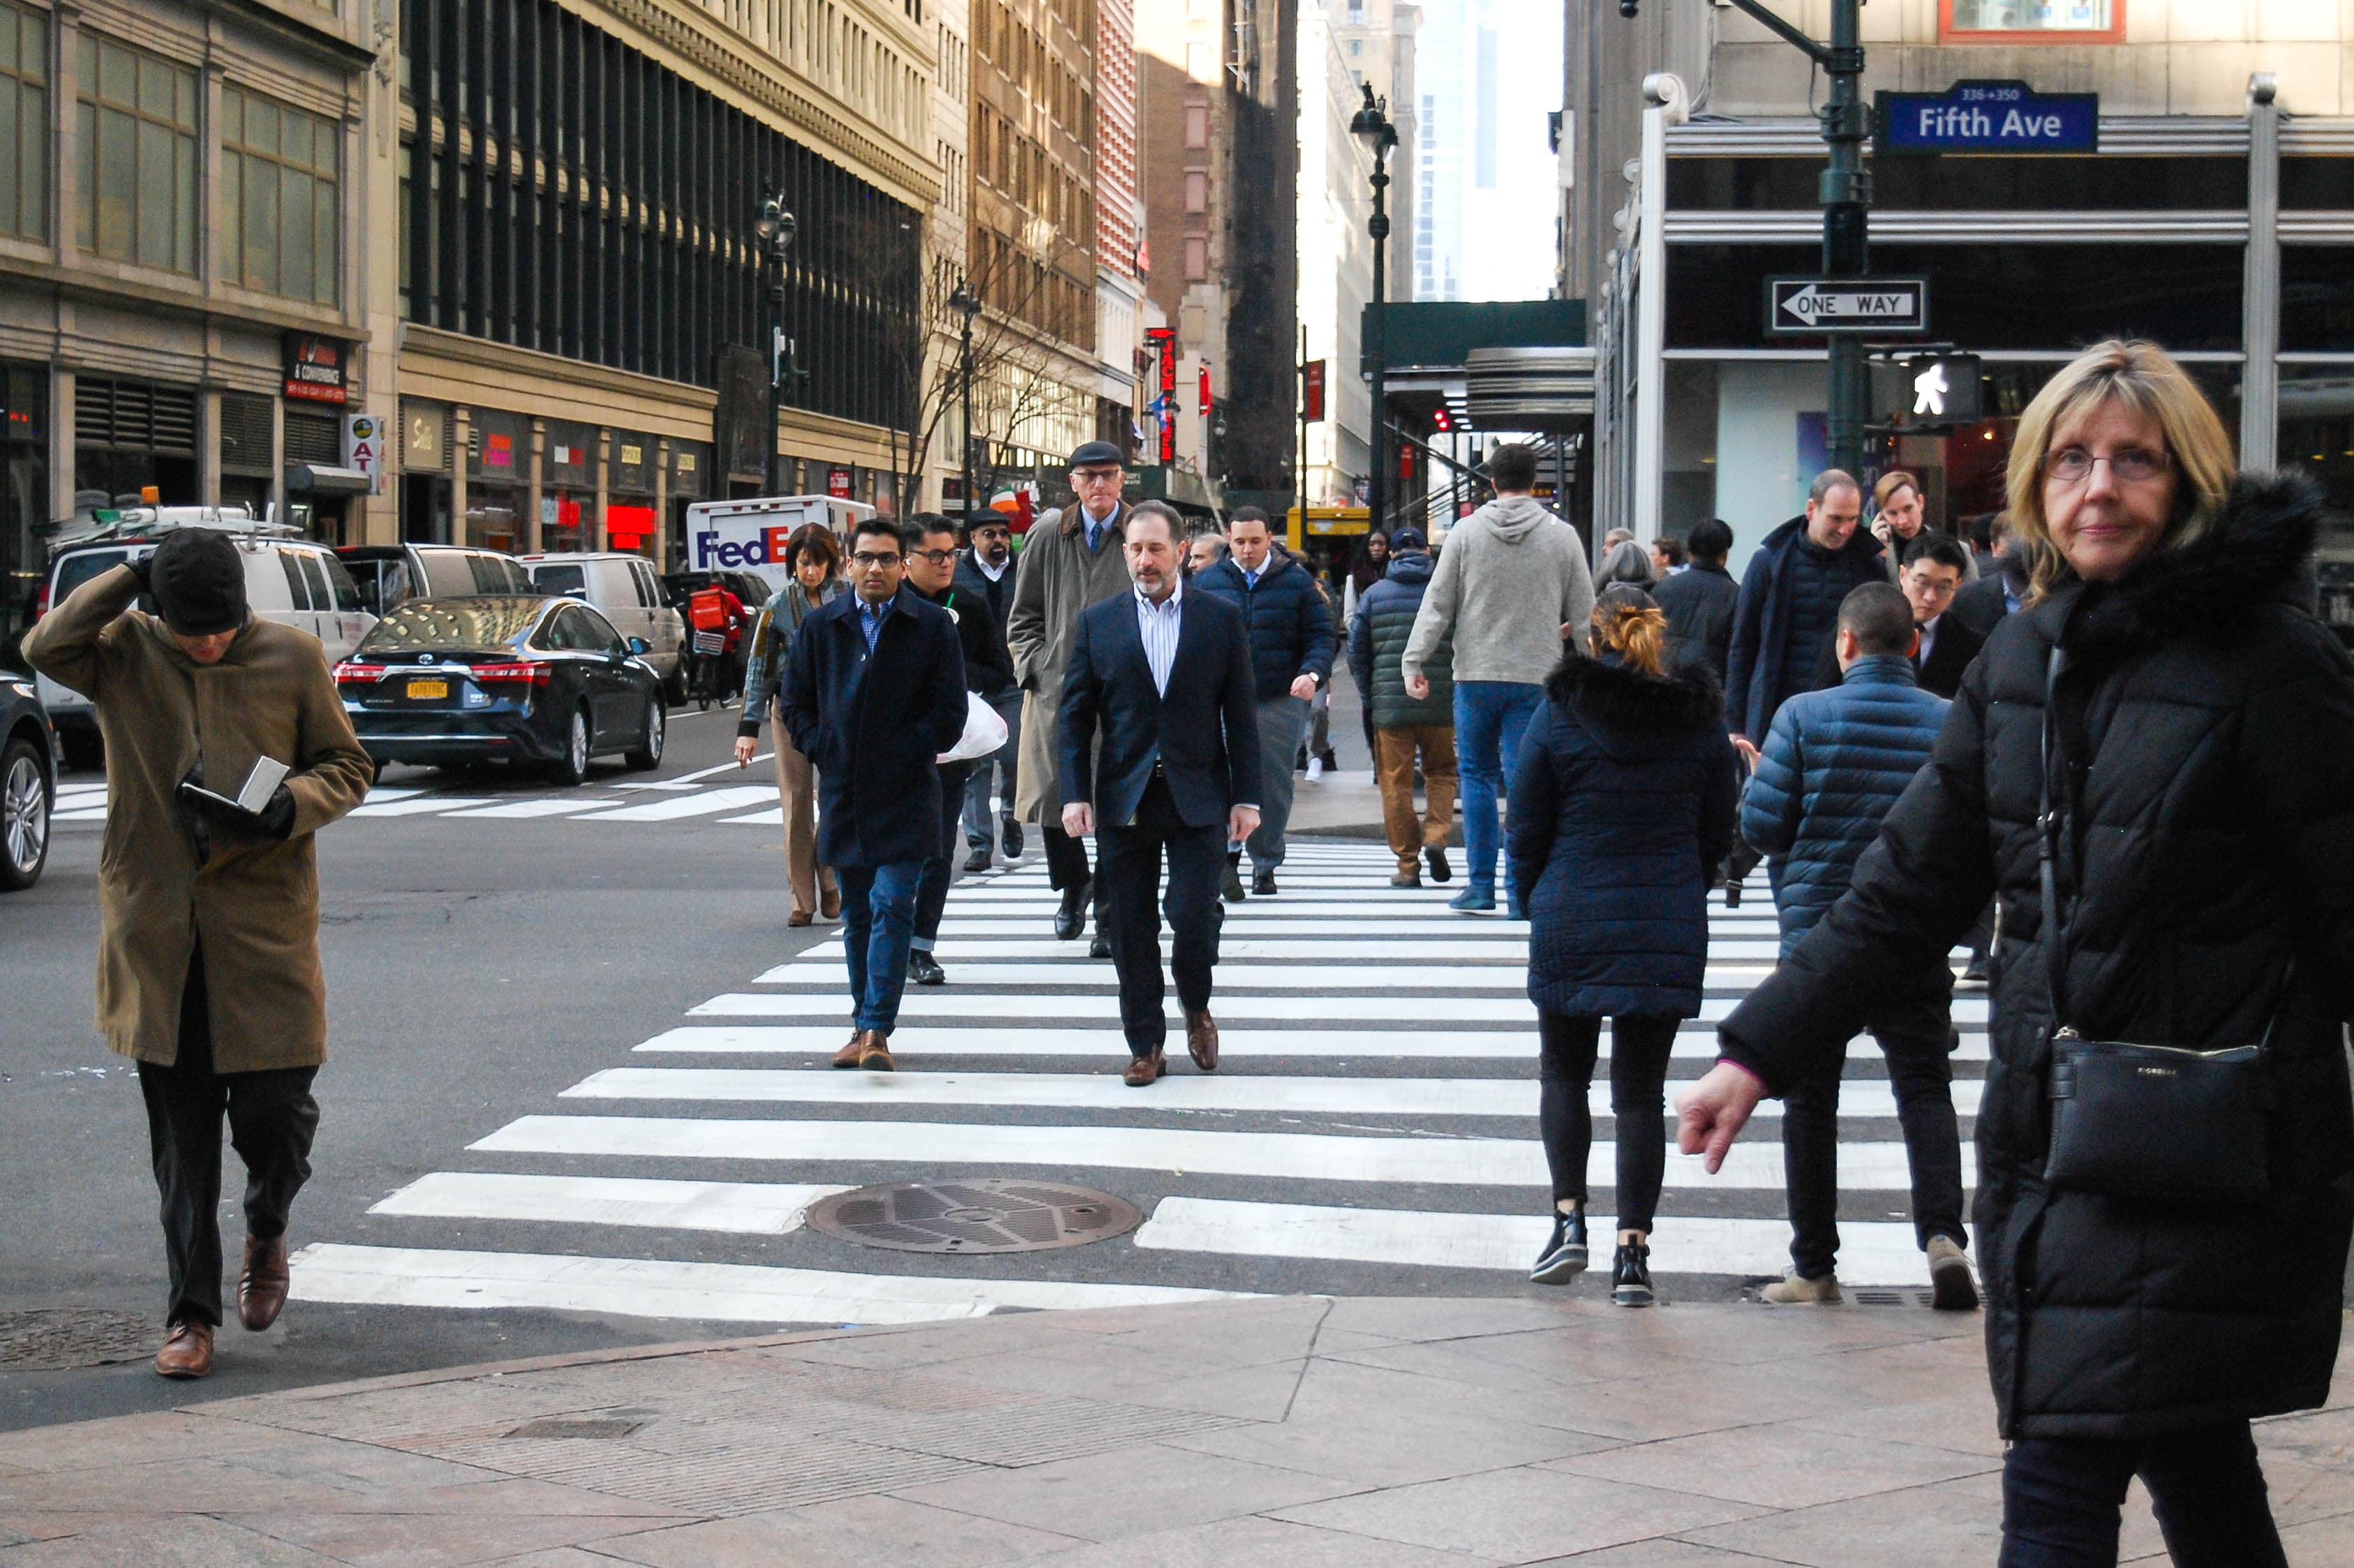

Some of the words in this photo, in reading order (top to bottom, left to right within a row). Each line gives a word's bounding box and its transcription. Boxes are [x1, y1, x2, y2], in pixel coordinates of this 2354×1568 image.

[1919, 107, 1989, 137] Fifth
[2000, 109, 2062, 137] Ave
[1798, 297, 1836, 314] ONE
[1857, 296, 1900, 313] WAY
[352, 442, 373, 489] AT
[696, 526, 788, 569] FedE
